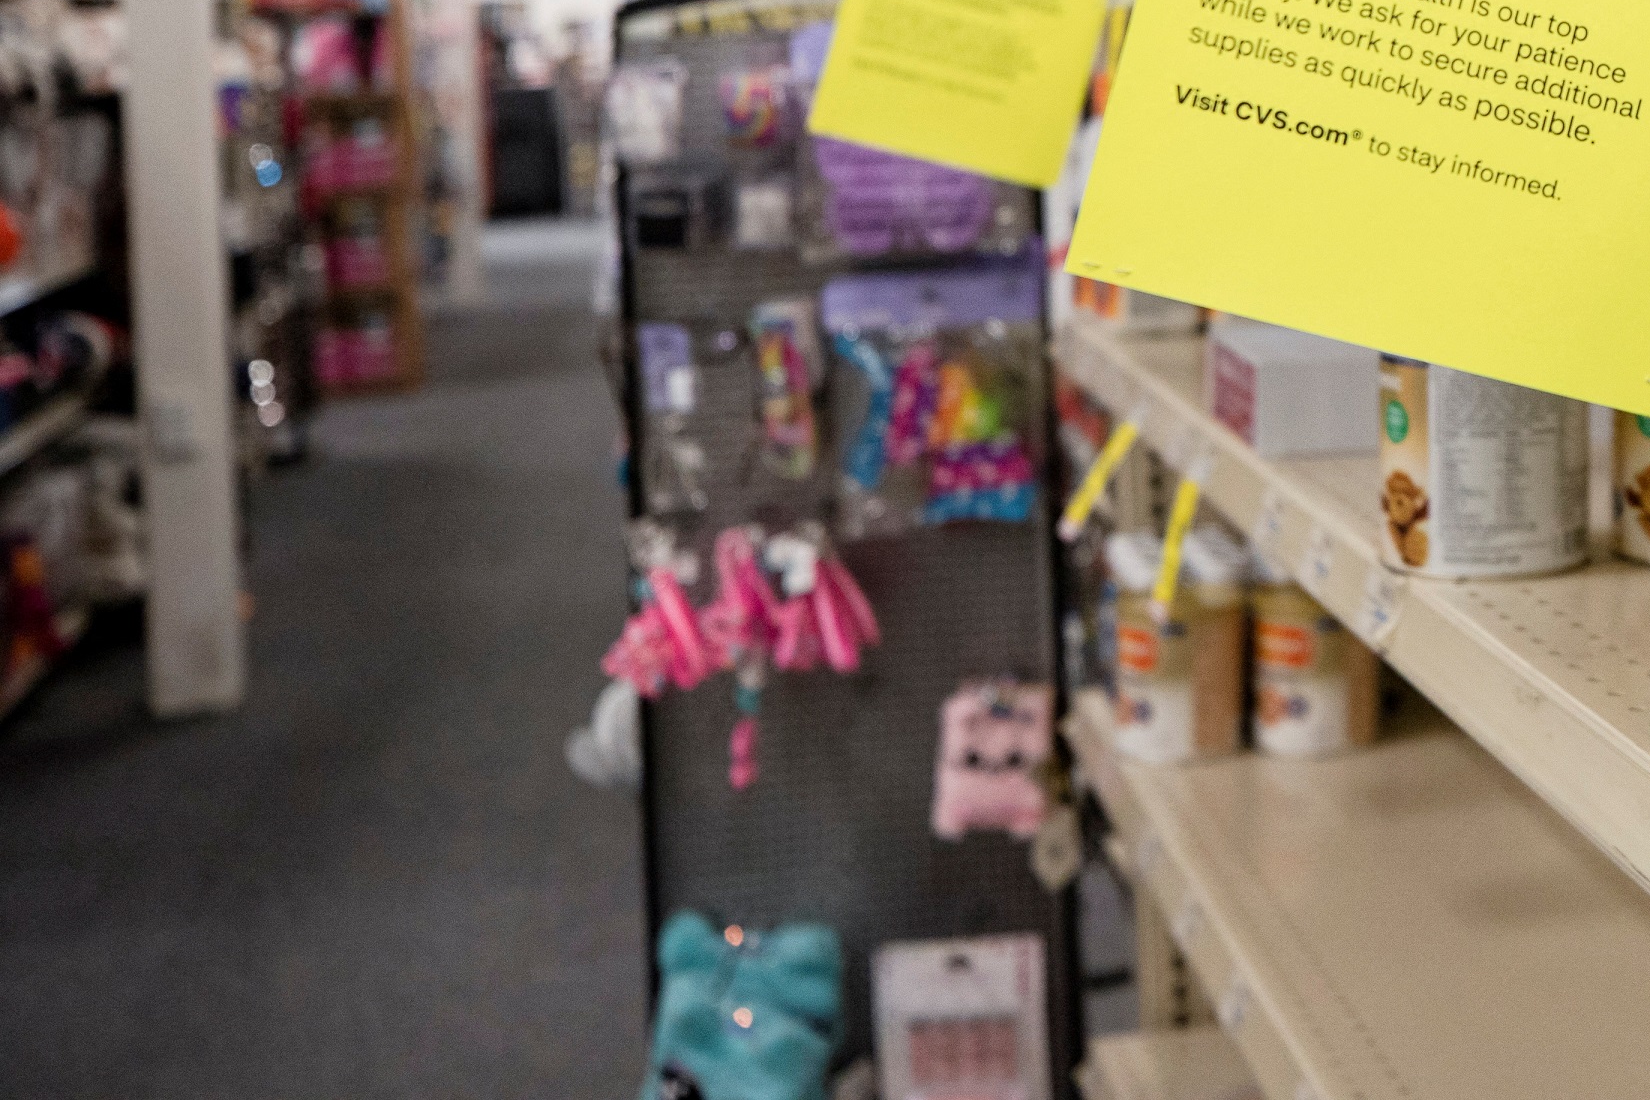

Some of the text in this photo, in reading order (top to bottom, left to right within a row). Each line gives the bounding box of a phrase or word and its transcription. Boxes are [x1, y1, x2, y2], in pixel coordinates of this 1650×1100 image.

[1275, 12, 1310, 34] we
[1320, 24, 1380, 52] work
[1389, 39, 1413, 60] to
[1420, 50, 1507, 84] secure
[1515, 74, 1641, 119] additional
[1359, 2, 1402, 25] ask
[1411, 10, 1446, 35] for
[1452, 26, 1510, 52] your
[1515, 43, 1625, 83] patience
[1498, 6, 1540, 27] our
[1548, 15, 1588, 44] top
[1189, 27, 1594, 144] supplies as quickly as possible.
[1176, 84, 1228, 115] Visit
[1369, 136, 1390, 155] to
[1397, 146, 1445, 173] stay
[1451, 155, 1560, 199] informed.
